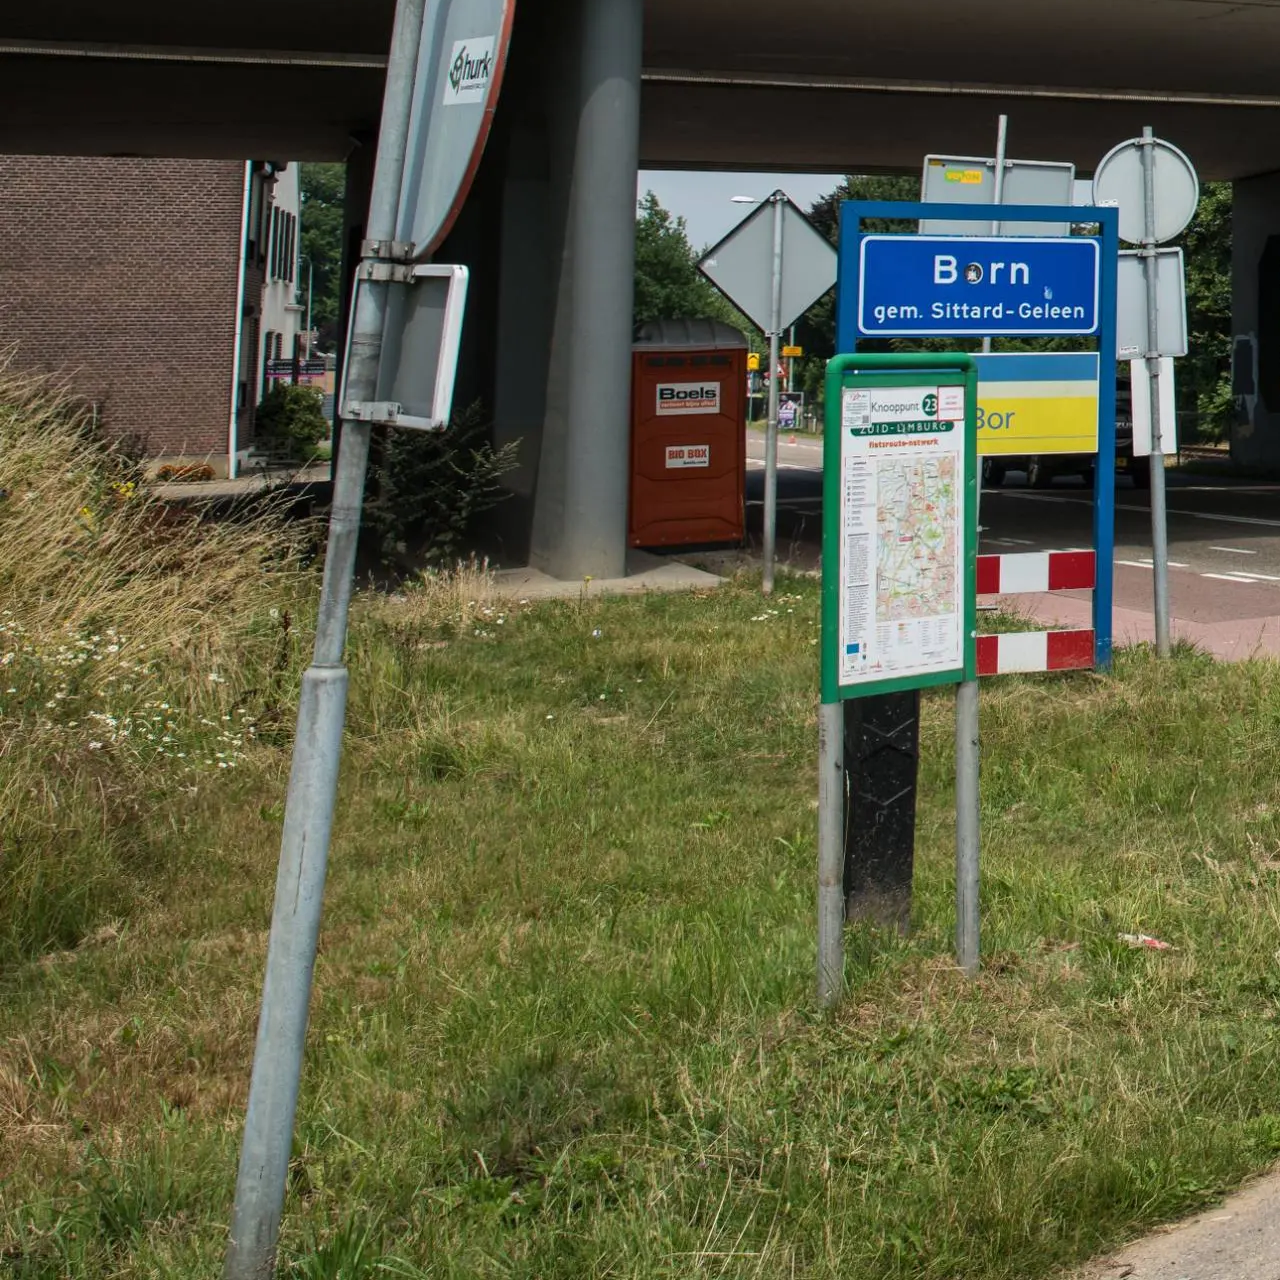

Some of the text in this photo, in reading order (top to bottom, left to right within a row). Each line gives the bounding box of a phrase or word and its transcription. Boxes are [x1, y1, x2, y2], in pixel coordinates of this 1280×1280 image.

[874, 302, 1085, 324] gem. Sittard-Geleen
[659, 387, 717, 400] Boels
[871, 402, 920, 413] Knooppunt
[925, 398, 938, 412] 23
[860, 422, 947, 434] ZUID-LIMBURG
